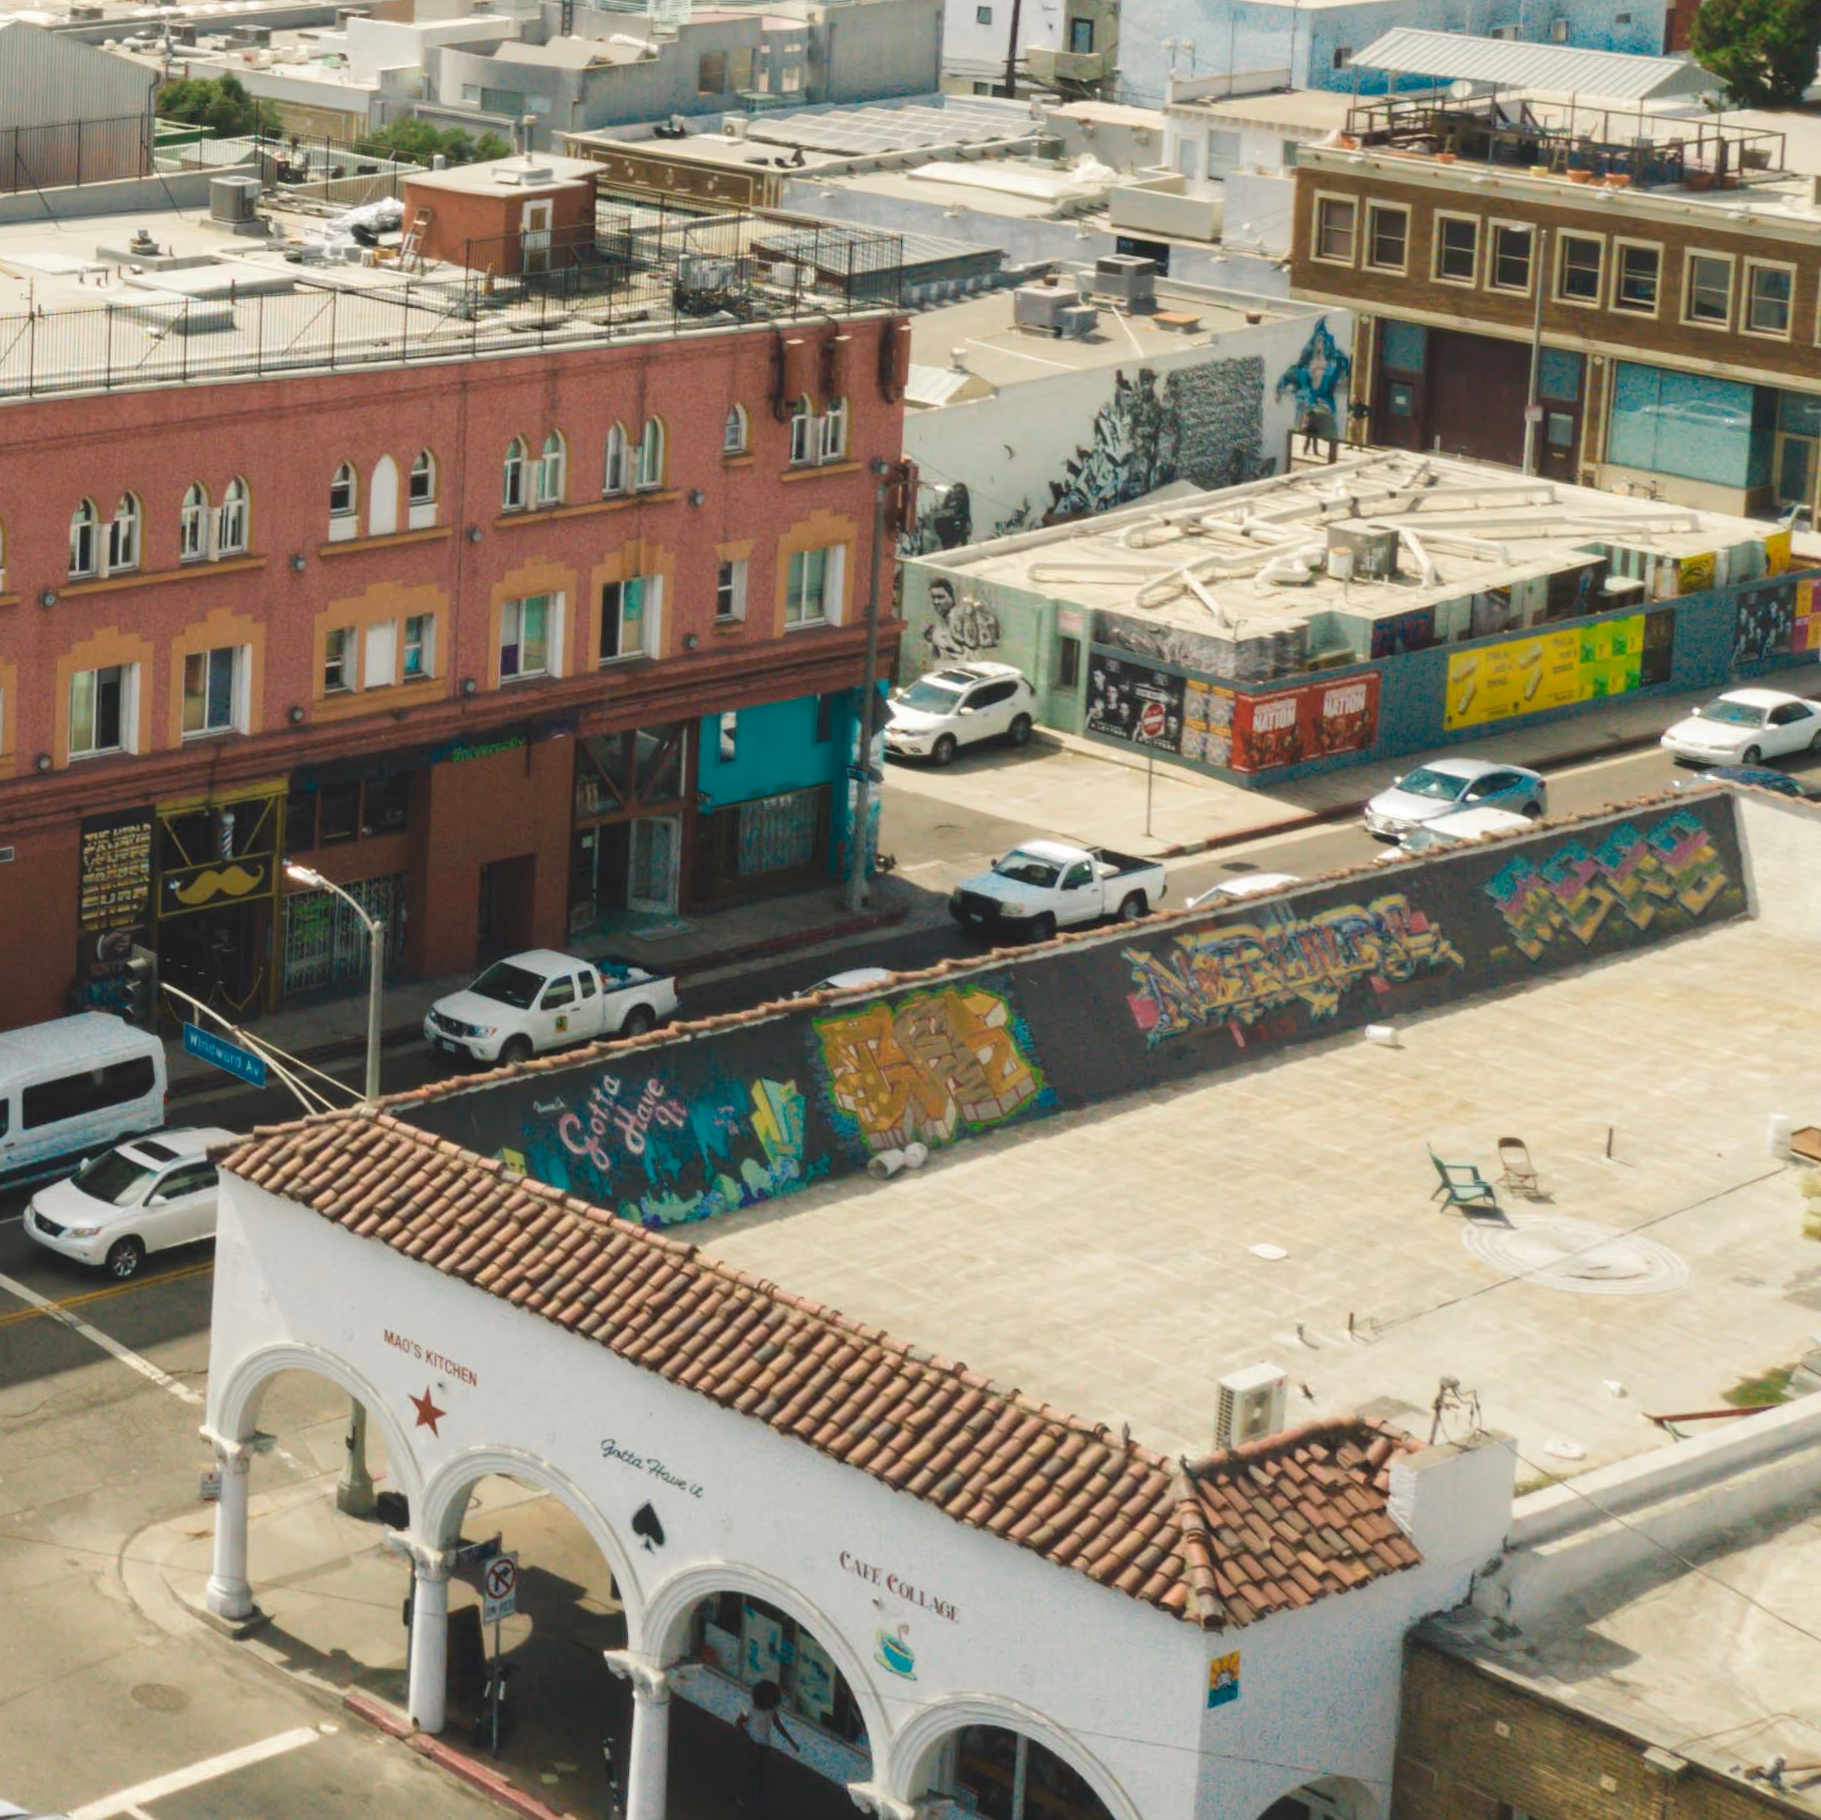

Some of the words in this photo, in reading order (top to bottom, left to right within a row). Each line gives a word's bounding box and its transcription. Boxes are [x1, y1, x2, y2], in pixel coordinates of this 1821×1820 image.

[189, 1032, 242, 1069] Windward
[245, 1060, 260, 1077] Av
[559, 1075, 621, 1171] Gotta
[613, 1078, 665, 1155] Have
[383, 1328, 422, 1360] MAO'S
[425, 1349, 478, 1388] KITCHEN
[600, 1438, 643, 1469] Gotta
[646, 1458, 687, 1490] Have
[689, 1483, 703, 1499] it
